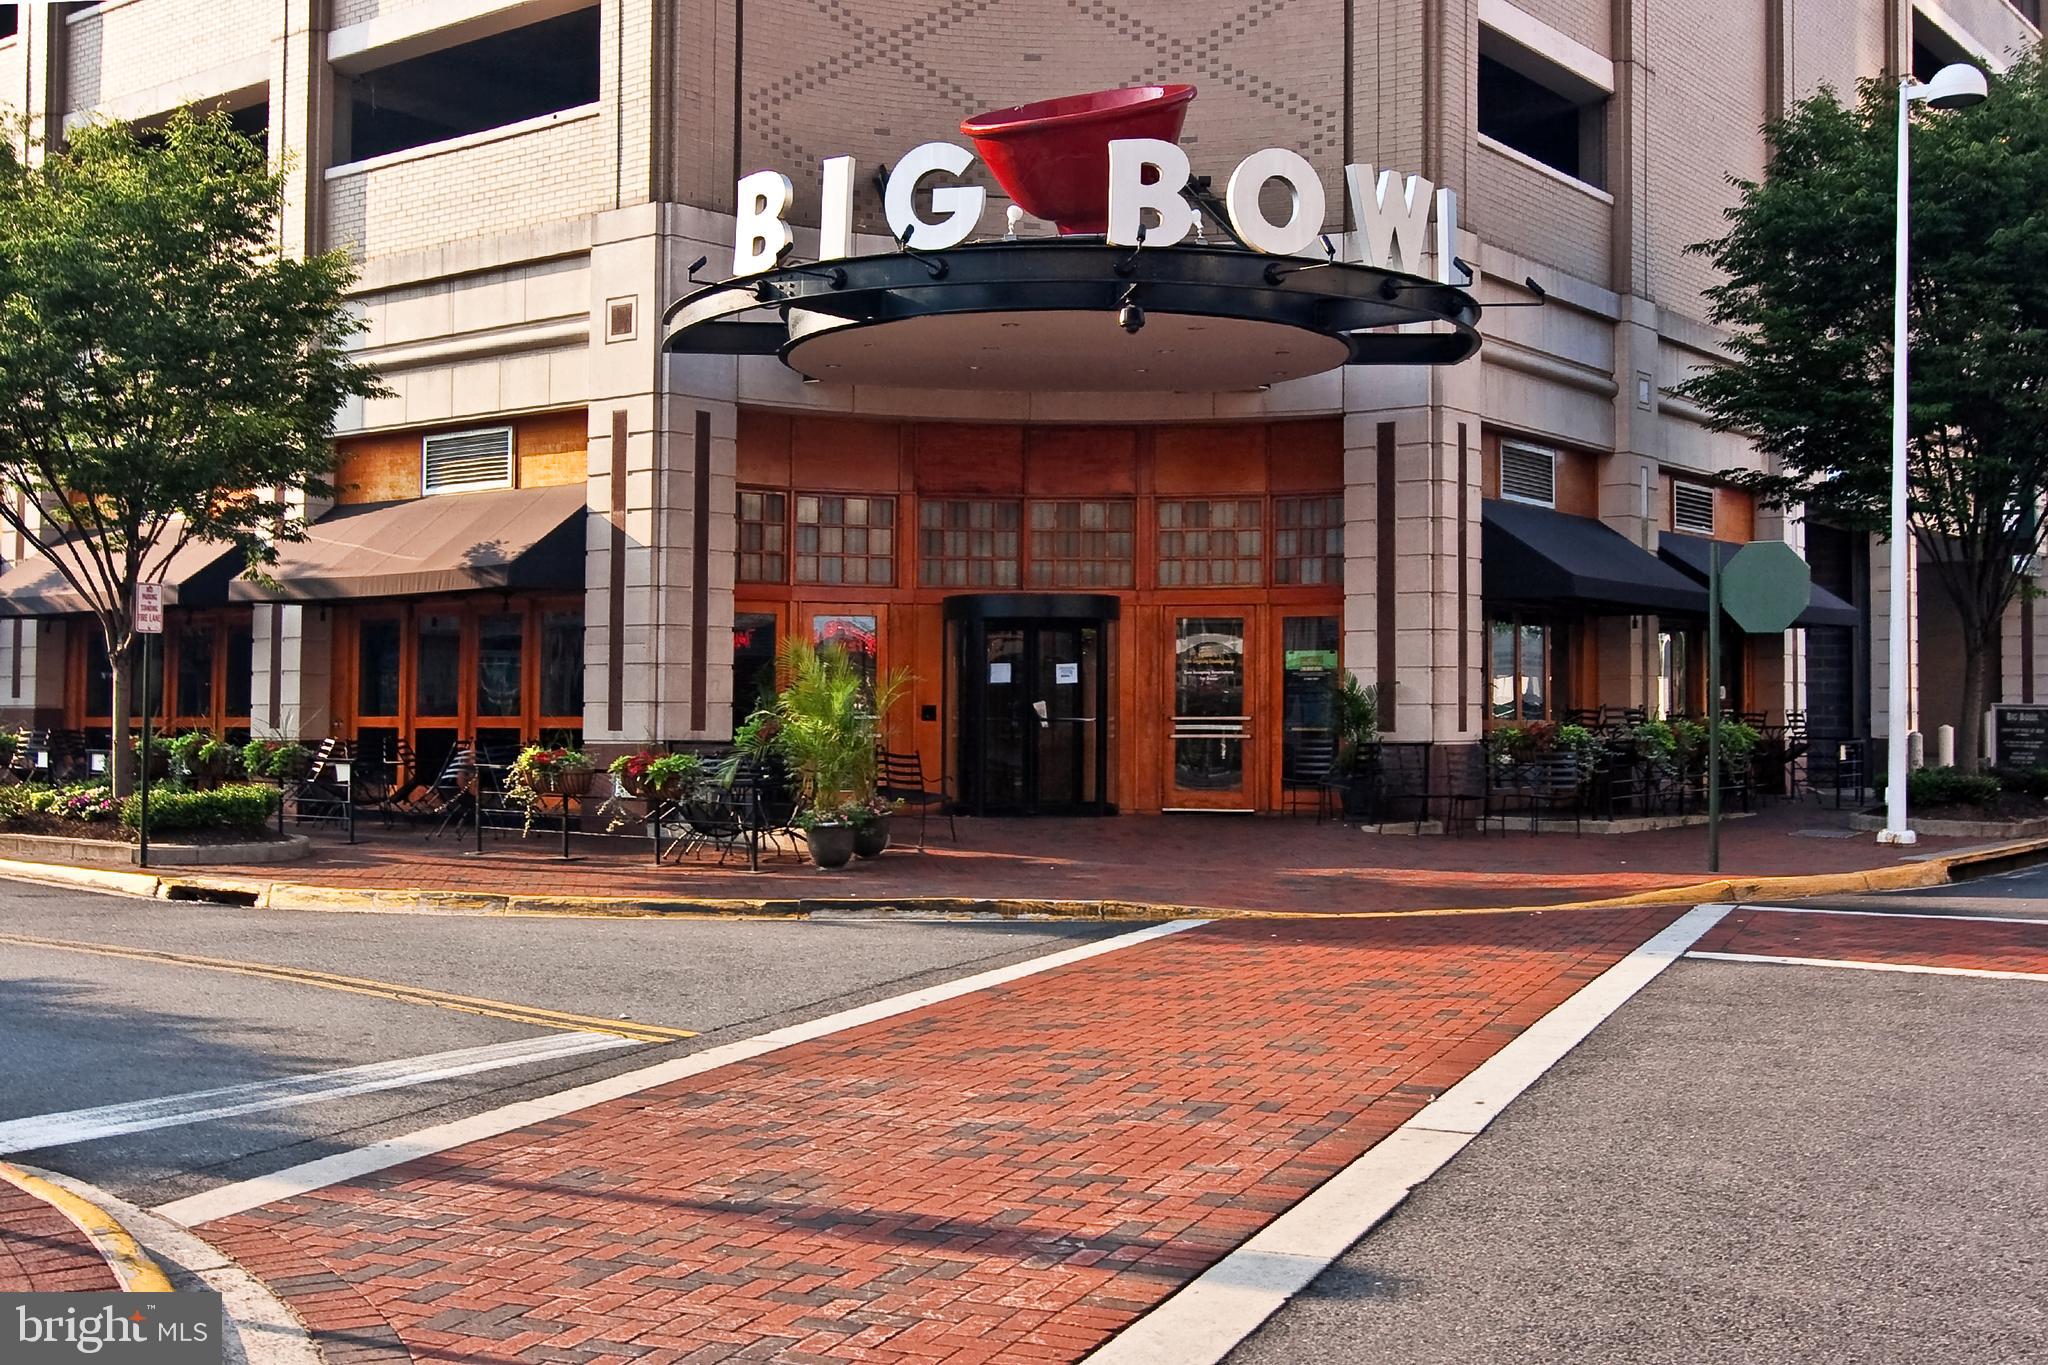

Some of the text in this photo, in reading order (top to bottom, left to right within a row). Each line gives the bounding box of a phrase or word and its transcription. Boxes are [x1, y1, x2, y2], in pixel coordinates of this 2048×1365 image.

[733, 138, 1458, 285] BIG BOWL
[138, 613, 148, 622] FIRE
